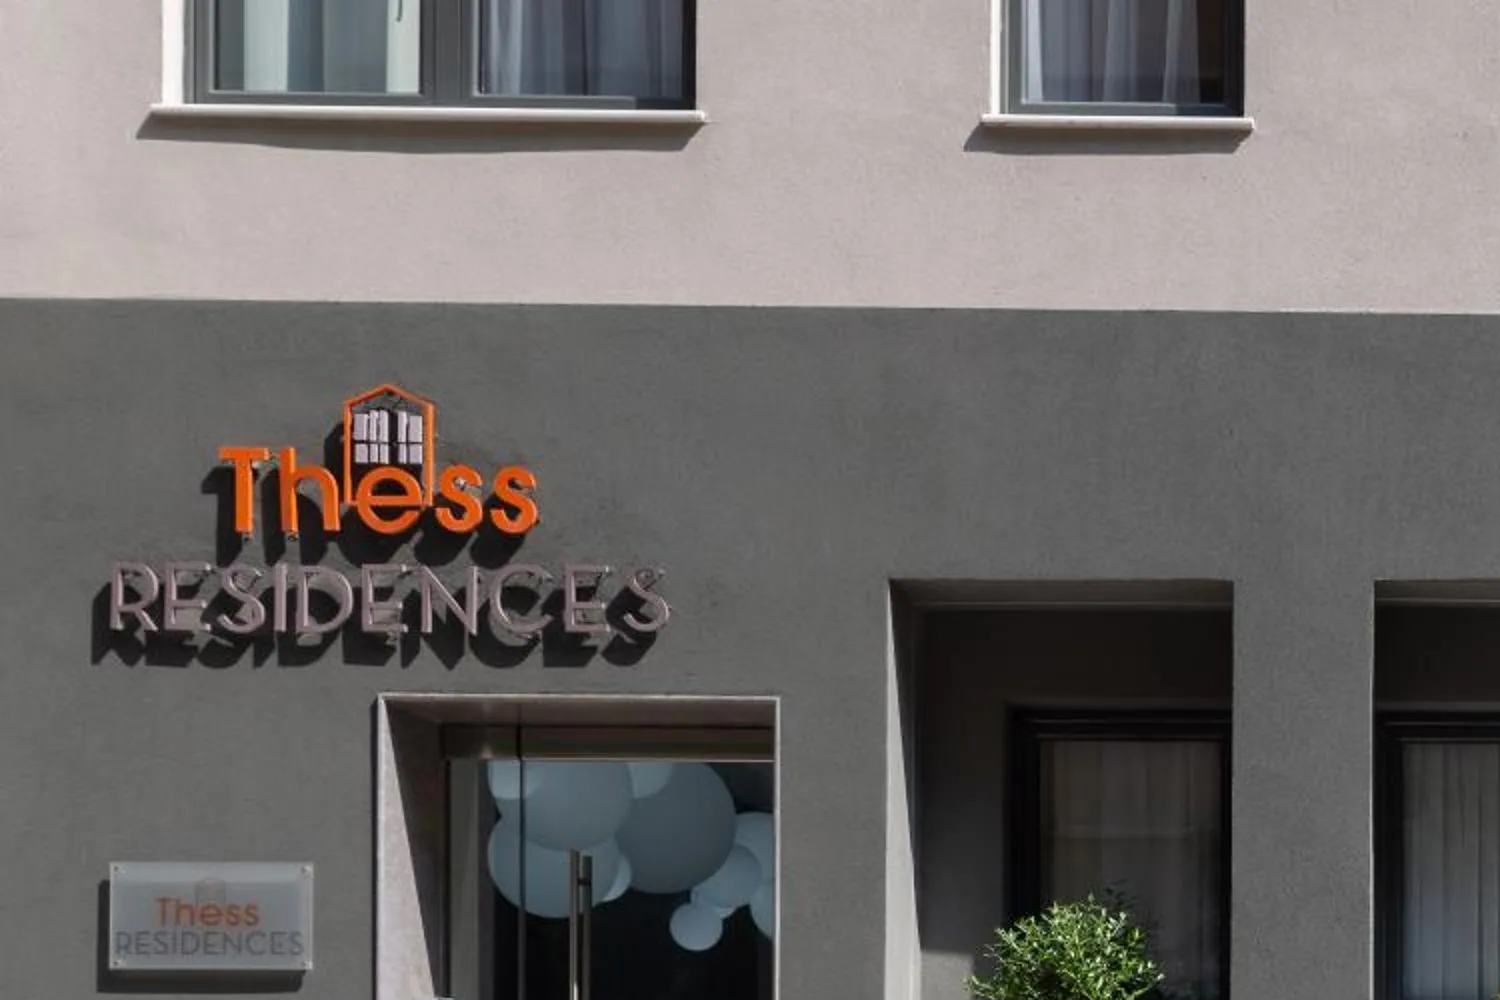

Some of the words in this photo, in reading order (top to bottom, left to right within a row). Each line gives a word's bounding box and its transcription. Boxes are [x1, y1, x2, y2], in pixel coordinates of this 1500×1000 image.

[218, 446, 541, 535] Thess
[108, 561, 671, 637] RESIDENCES
[155, 896, 261, 927] Thess
[114, 930, 305, 956] RESIDENCES
